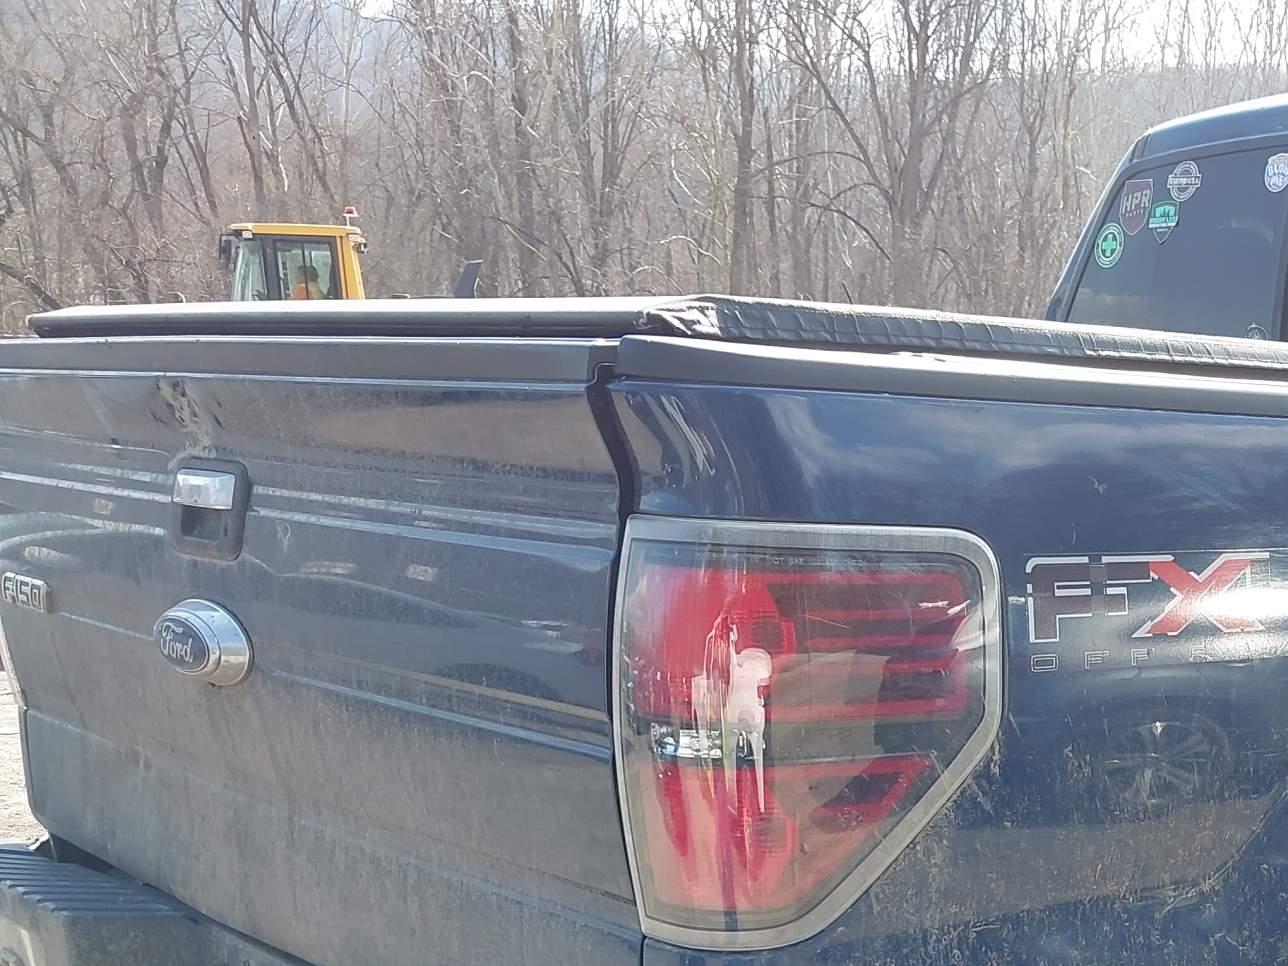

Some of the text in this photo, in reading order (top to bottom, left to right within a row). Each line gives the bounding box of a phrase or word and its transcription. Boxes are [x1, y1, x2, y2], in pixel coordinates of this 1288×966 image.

[1121, 189, 1151, 214] HPR
[160, 621, 194, 664] Ford
[1030, 648, 1155, 672] OFF
